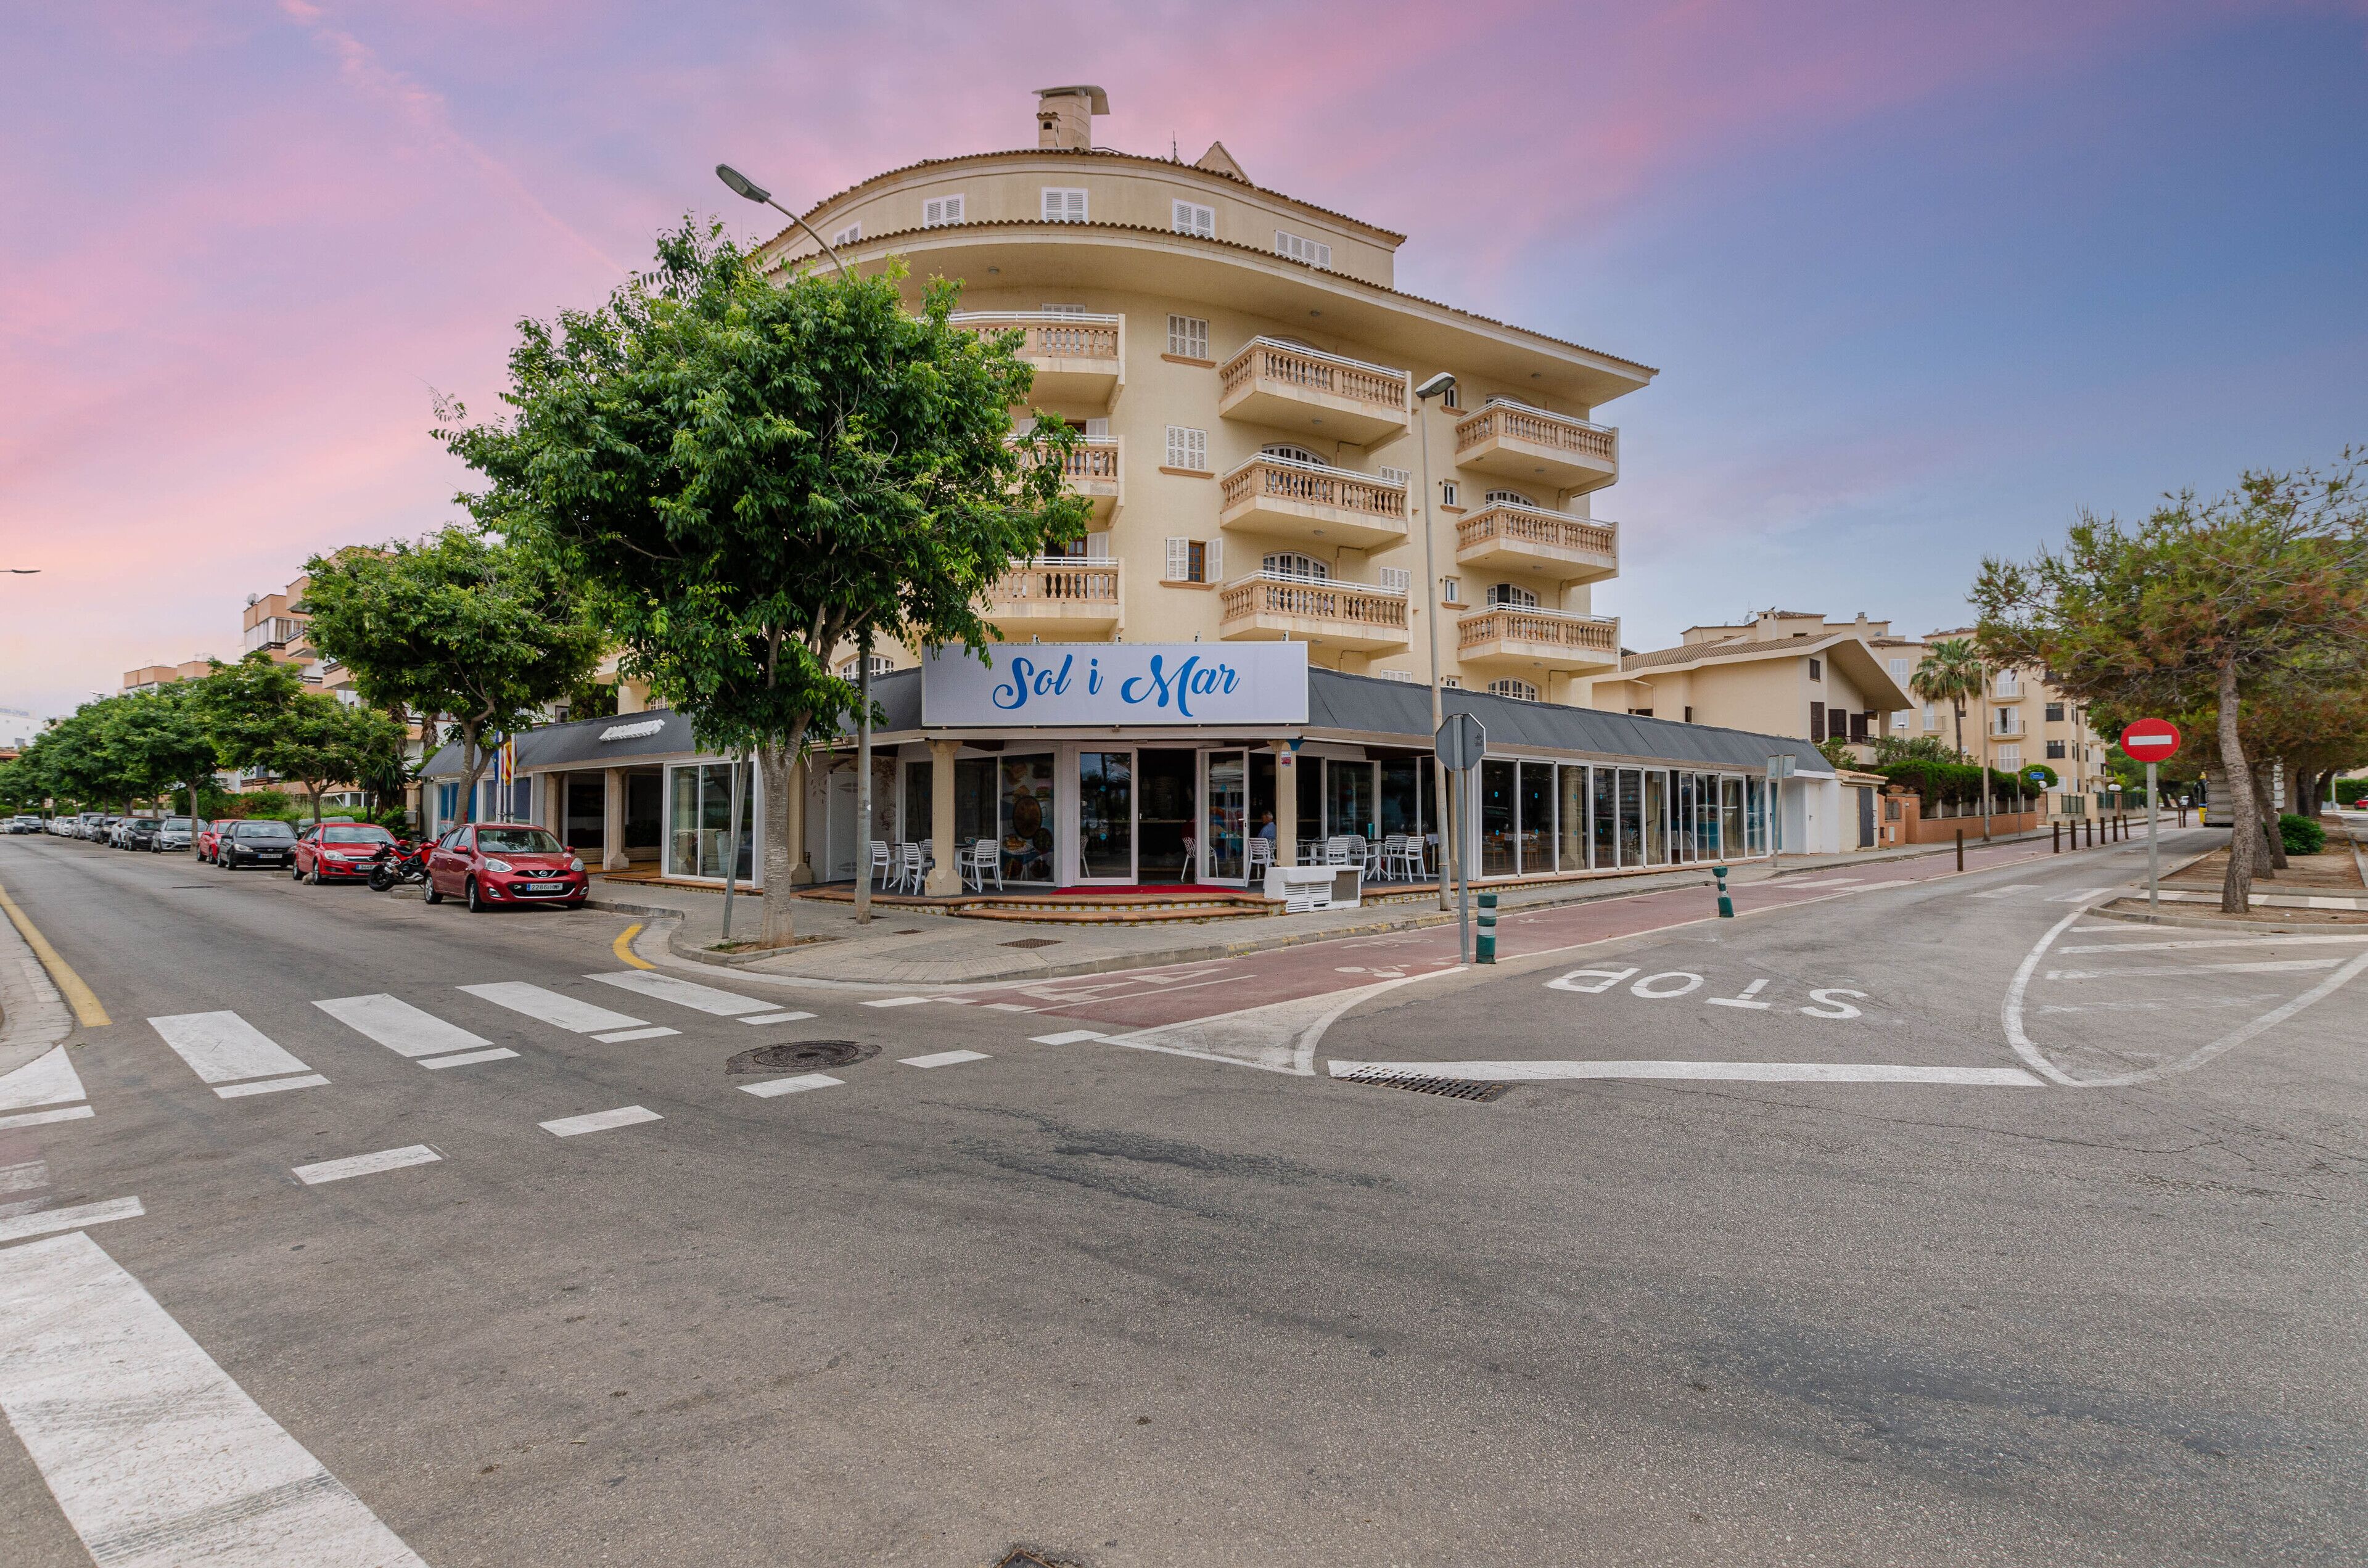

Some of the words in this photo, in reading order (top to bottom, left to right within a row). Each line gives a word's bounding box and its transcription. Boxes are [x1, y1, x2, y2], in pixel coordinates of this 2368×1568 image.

[993, 654, 1073, 710] Sol
[1088, 658, 1103, 695] i
[1120, 654, 1240, 717] Mar
[1547, 968, 1868, 1019] STOP
